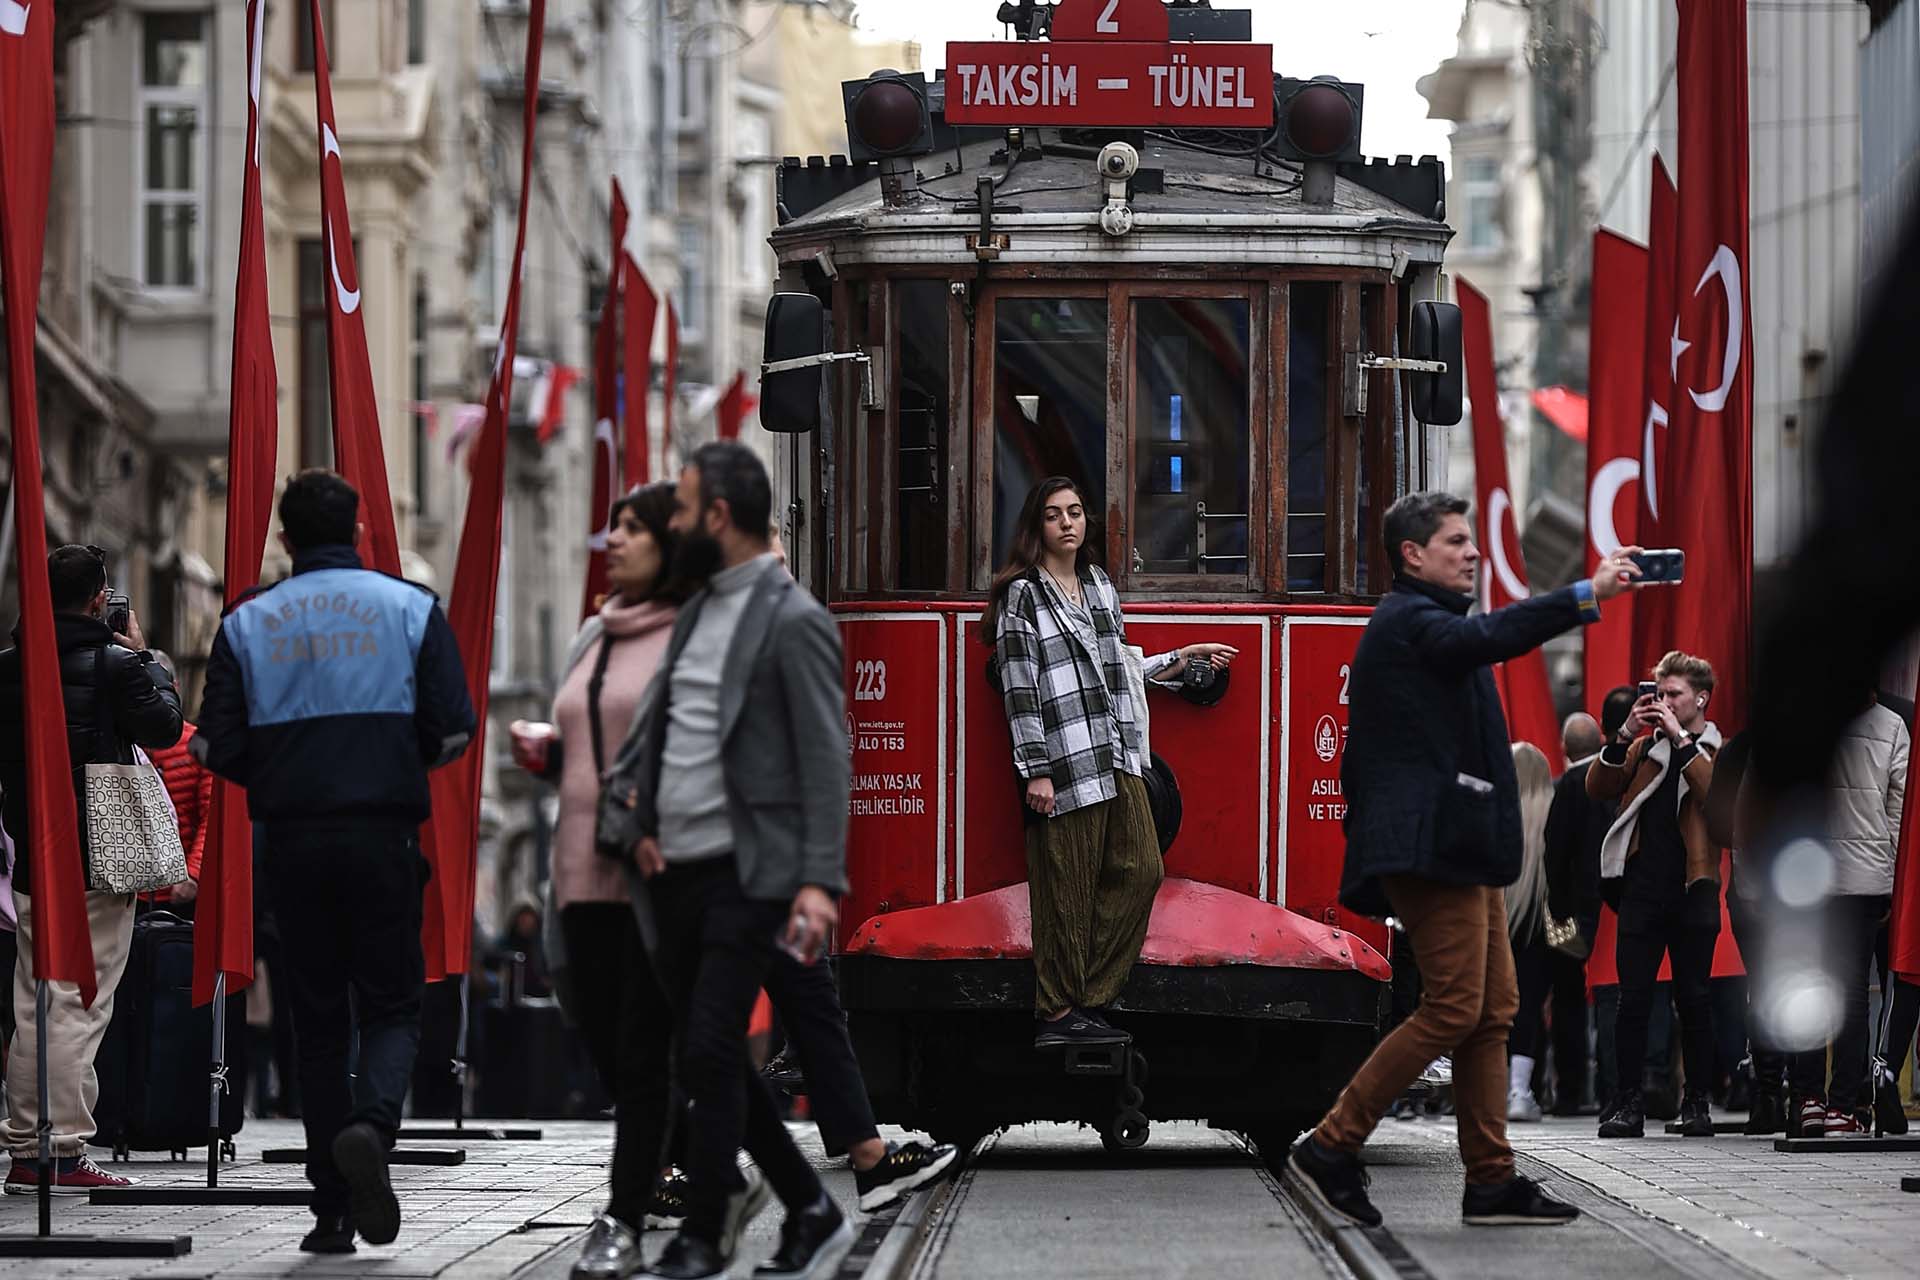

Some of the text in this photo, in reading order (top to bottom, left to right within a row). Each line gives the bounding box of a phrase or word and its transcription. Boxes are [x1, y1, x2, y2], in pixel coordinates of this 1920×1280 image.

[1096, 0, 1119, 33] 2
[957, 54, 1077, 106] TAKSİM
[1148, 54, 1255, 107] TÜNEL
[855, 660, 886, 701] 223
[858, 737, 879, 750] ALO
[882, 737, 905, 750] 153
[882, 773, 922, 790] YASAK
[1308, 803, 1324, 820] VE
